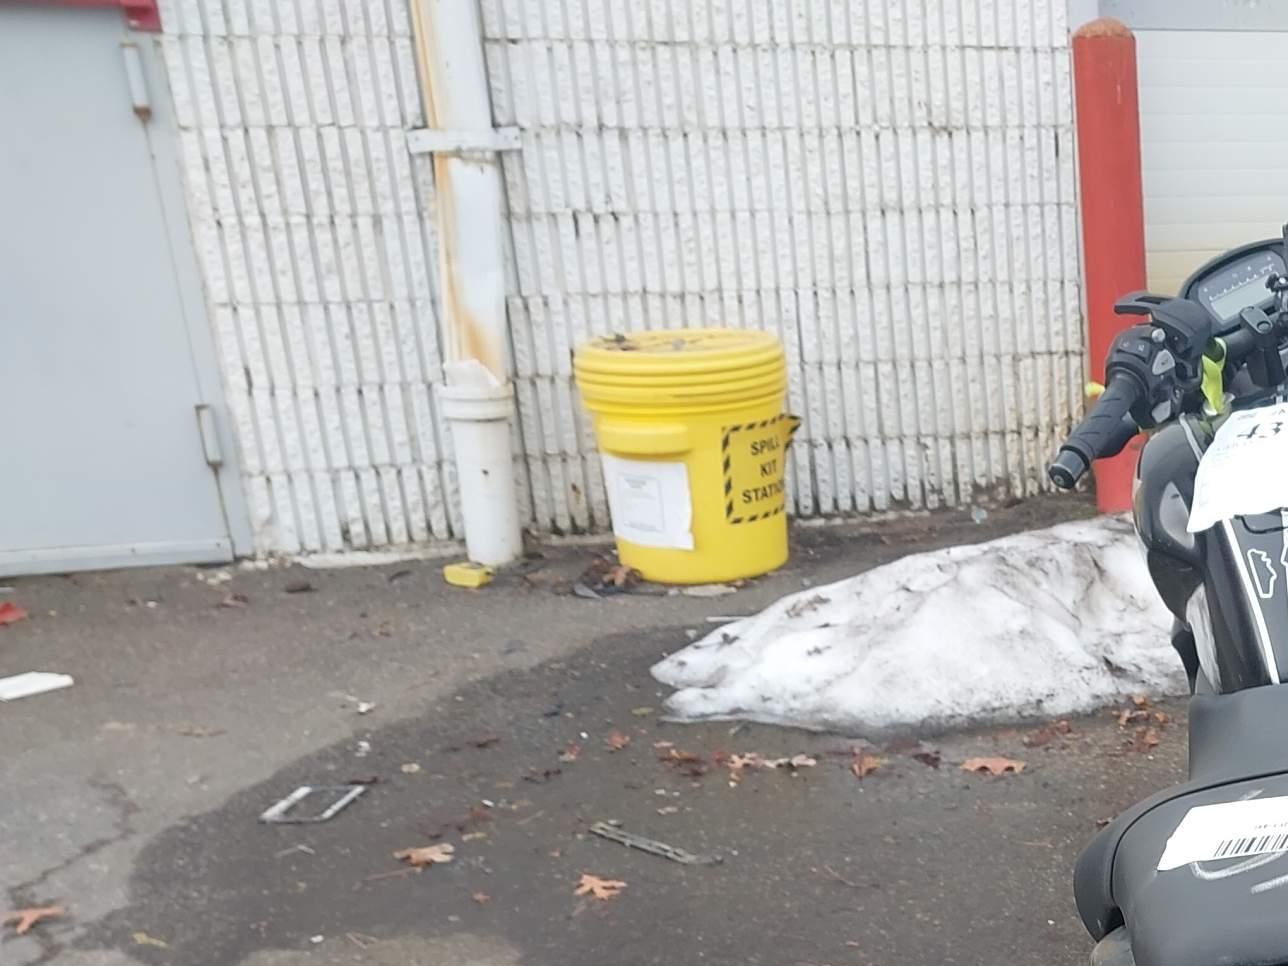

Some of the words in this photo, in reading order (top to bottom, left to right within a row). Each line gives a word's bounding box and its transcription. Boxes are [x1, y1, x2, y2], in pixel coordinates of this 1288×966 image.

[751, 434, 780, 456] SPILL
[760, 459, 777, 478] KIT
[742, 479, 785, 504] STATIO
